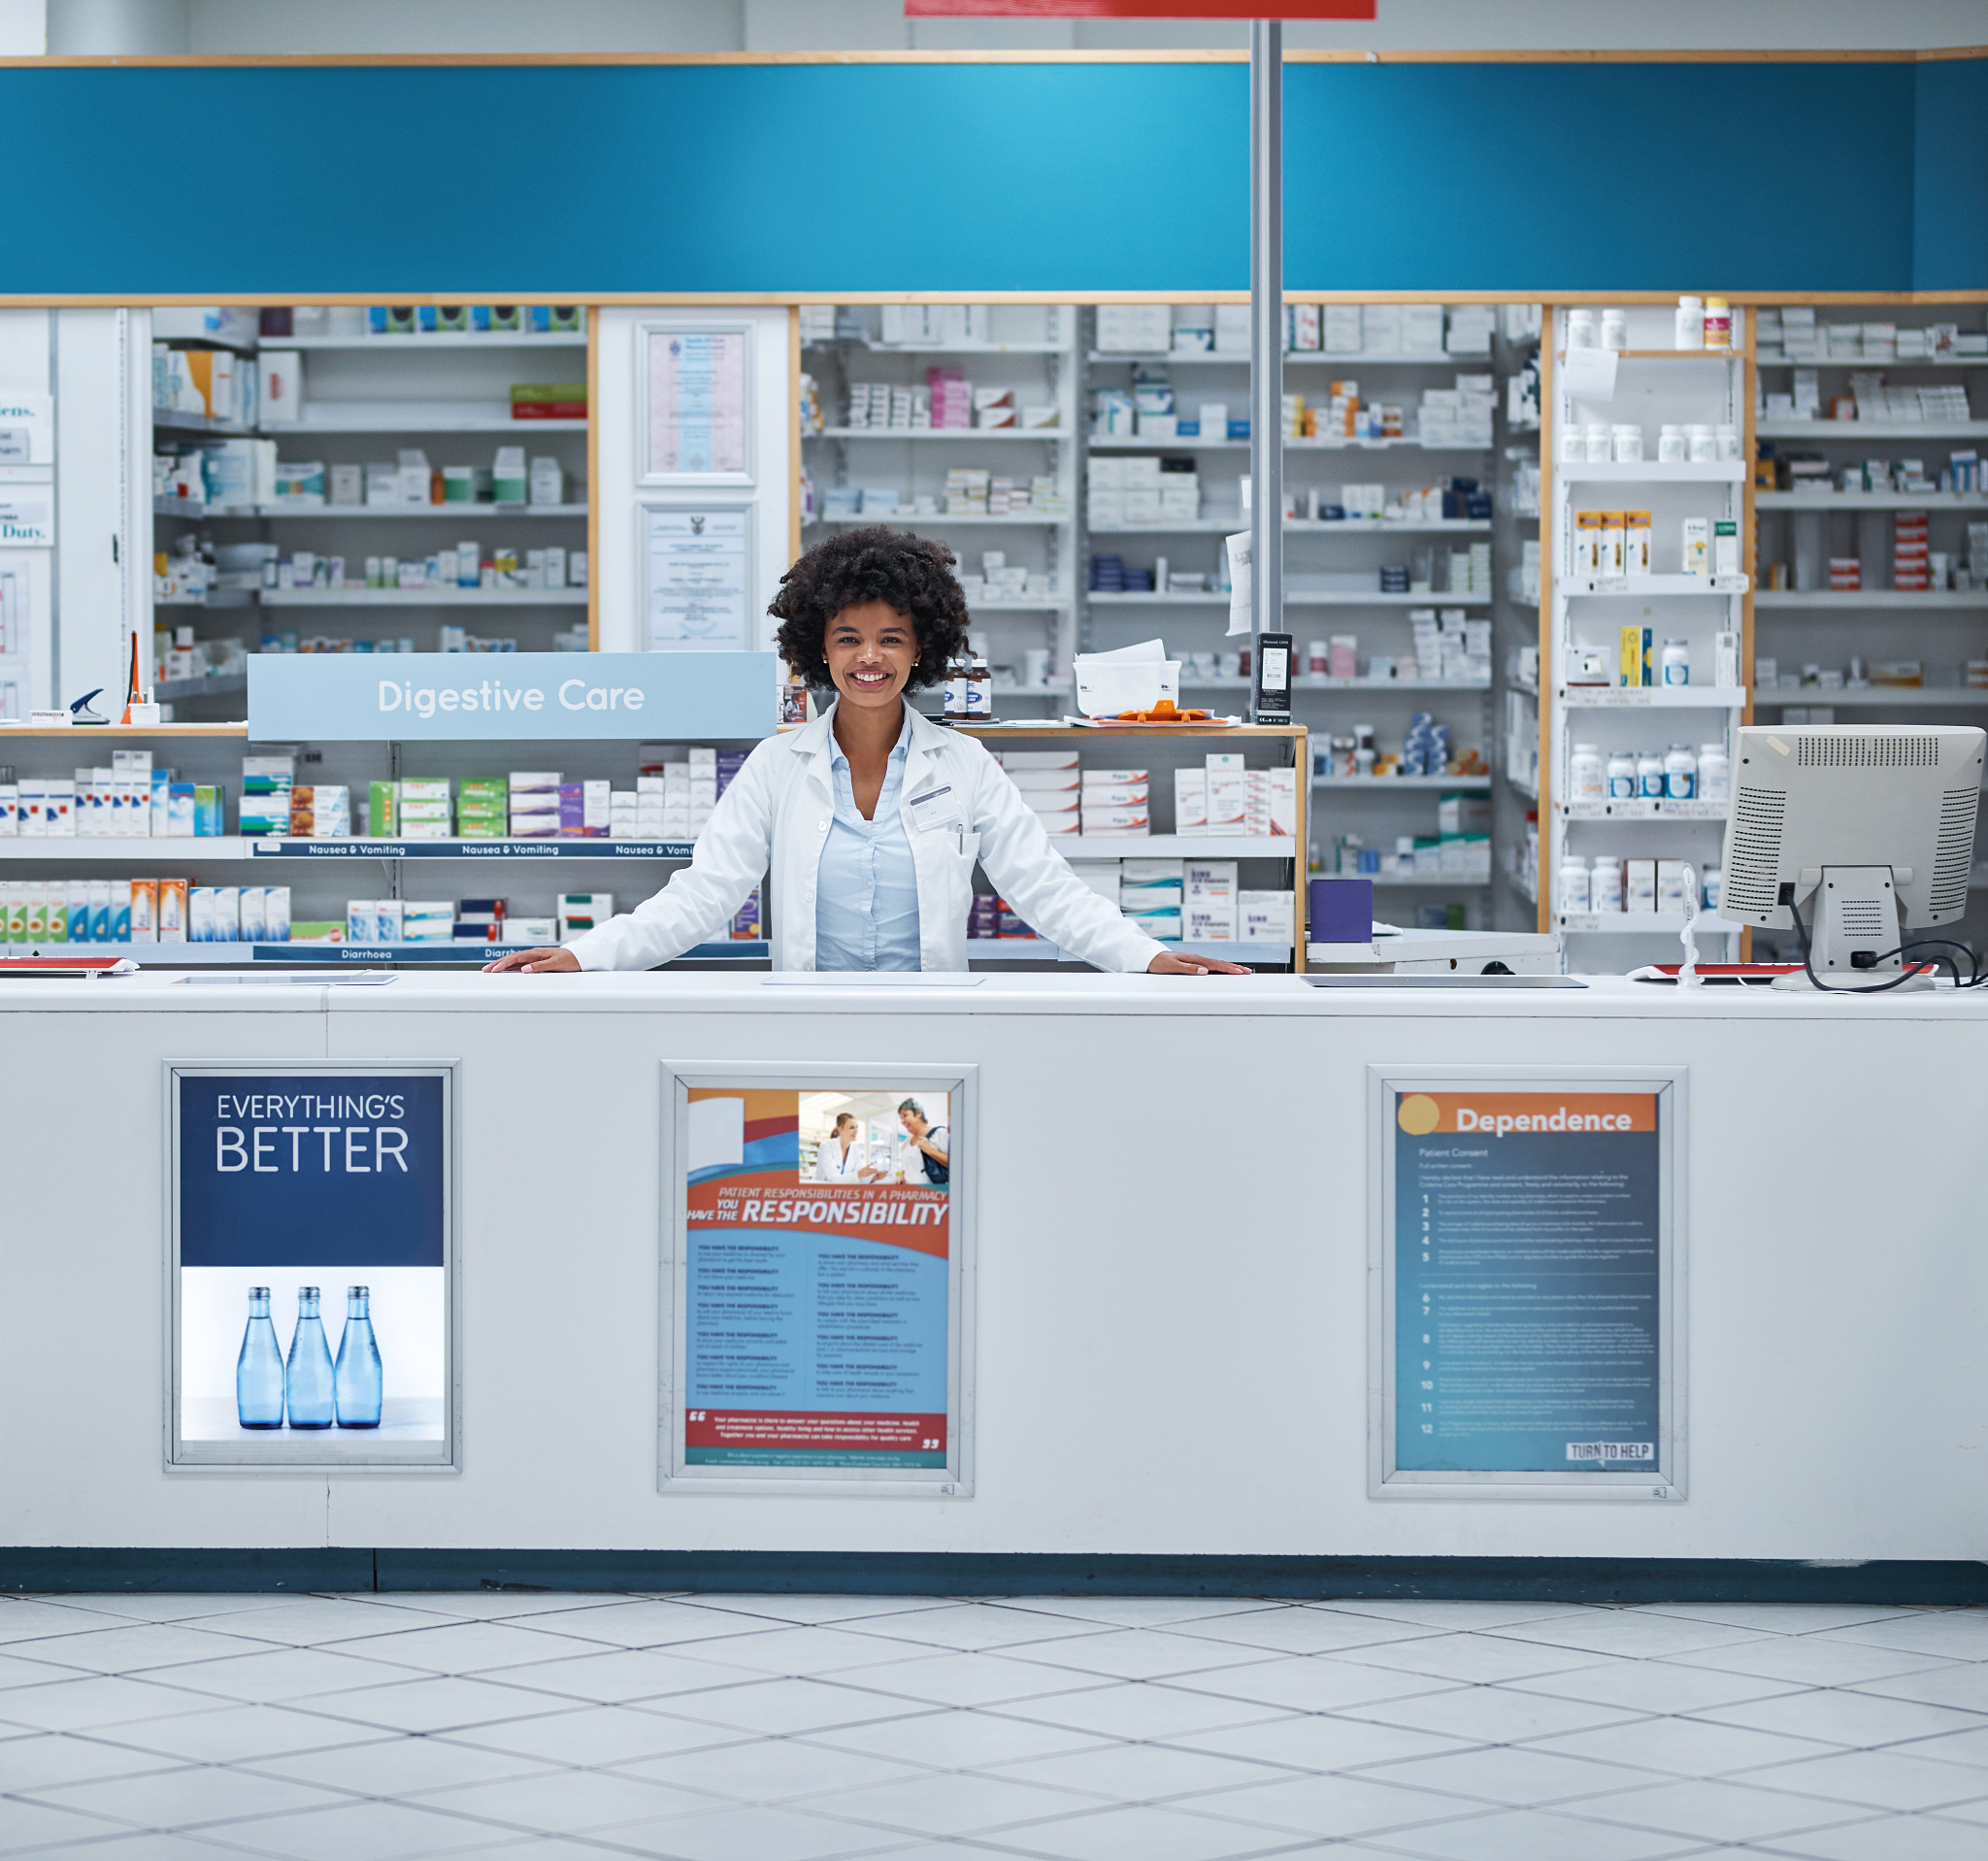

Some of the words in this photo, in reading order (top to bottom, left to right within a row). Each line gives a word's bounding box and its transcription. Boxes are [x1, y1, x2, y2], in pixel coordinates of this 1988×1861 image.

[0, 403, 35, 416] ens.
[3, 523, 46, 543] Duty.
[379, 680, 546, 718] Digestive
[558, 679, 645, 711] Care
[309, 846, 348, 854] Nausea
[349, 846, 356, 854] &
[359, 846, 406, 855] Vomiting
[462, 846, 501, 854] Nausea
[503, 846, 510, 854] &
[514, 846, 559, 855] Vomiting
[615, 846, 653, 854] Nausea
[656, 846, 663, 854] &
[667, 846, 693, 854] Vomi
[342, 949, 392, 958] Diarrhoea
[485, 948, 520, 957] Diarrh
[217, 1094, 405, 1119] EVERYTHING'S
[1457, 1107, 1632, 1138] Dependence
[216, 1126, 409, 1173] BETTER
[1419, 1147, 1450, 1157] Patient
[1451, 1147, 1489, 1157] Consent
[718, 1187, 761, 1198] PATIENT
[763, 1188, 861, 1200] RESPONSIBILITIES
[862, 1189, 876, 1200] IN
[878, 1190, 888, 1200] A
[889, 1190, 947, 1202] PHARMACY
[1422, 1194, 1429, 1204] 1
[716, 1199, 739, 1210] YOU
[687, 1210, 715, 1220] HAVE
[716, 1211, 739, 1221] THE
[741, 1200, 948, 1226] RESPONSIBILITY
[1422, 1208, 1430, 1217] 2
[1422, 1221, 1430, 1231] 3
[1421, 1236, 1430, 1246] 4
[1422, 1252, 1430, 1262] 5
[1422, 1293, 1430, 1302] 6
[1422, 1306, 1430, 1315] 7
[1422, 1334, 1430, 1344] 8
[1422, 1360, 1430, 1370] 9
[1421, 1380, 1433, 1390] 10
[1421, 1403, 1432, 1412] 11
[1421, 1424, 1433, 1434] 12
[1572, 1443, 1602, 1458] TURN
[1604, 1445, 1618, 1458] TO
[1621, 1445, 1649, 1458] HELP
